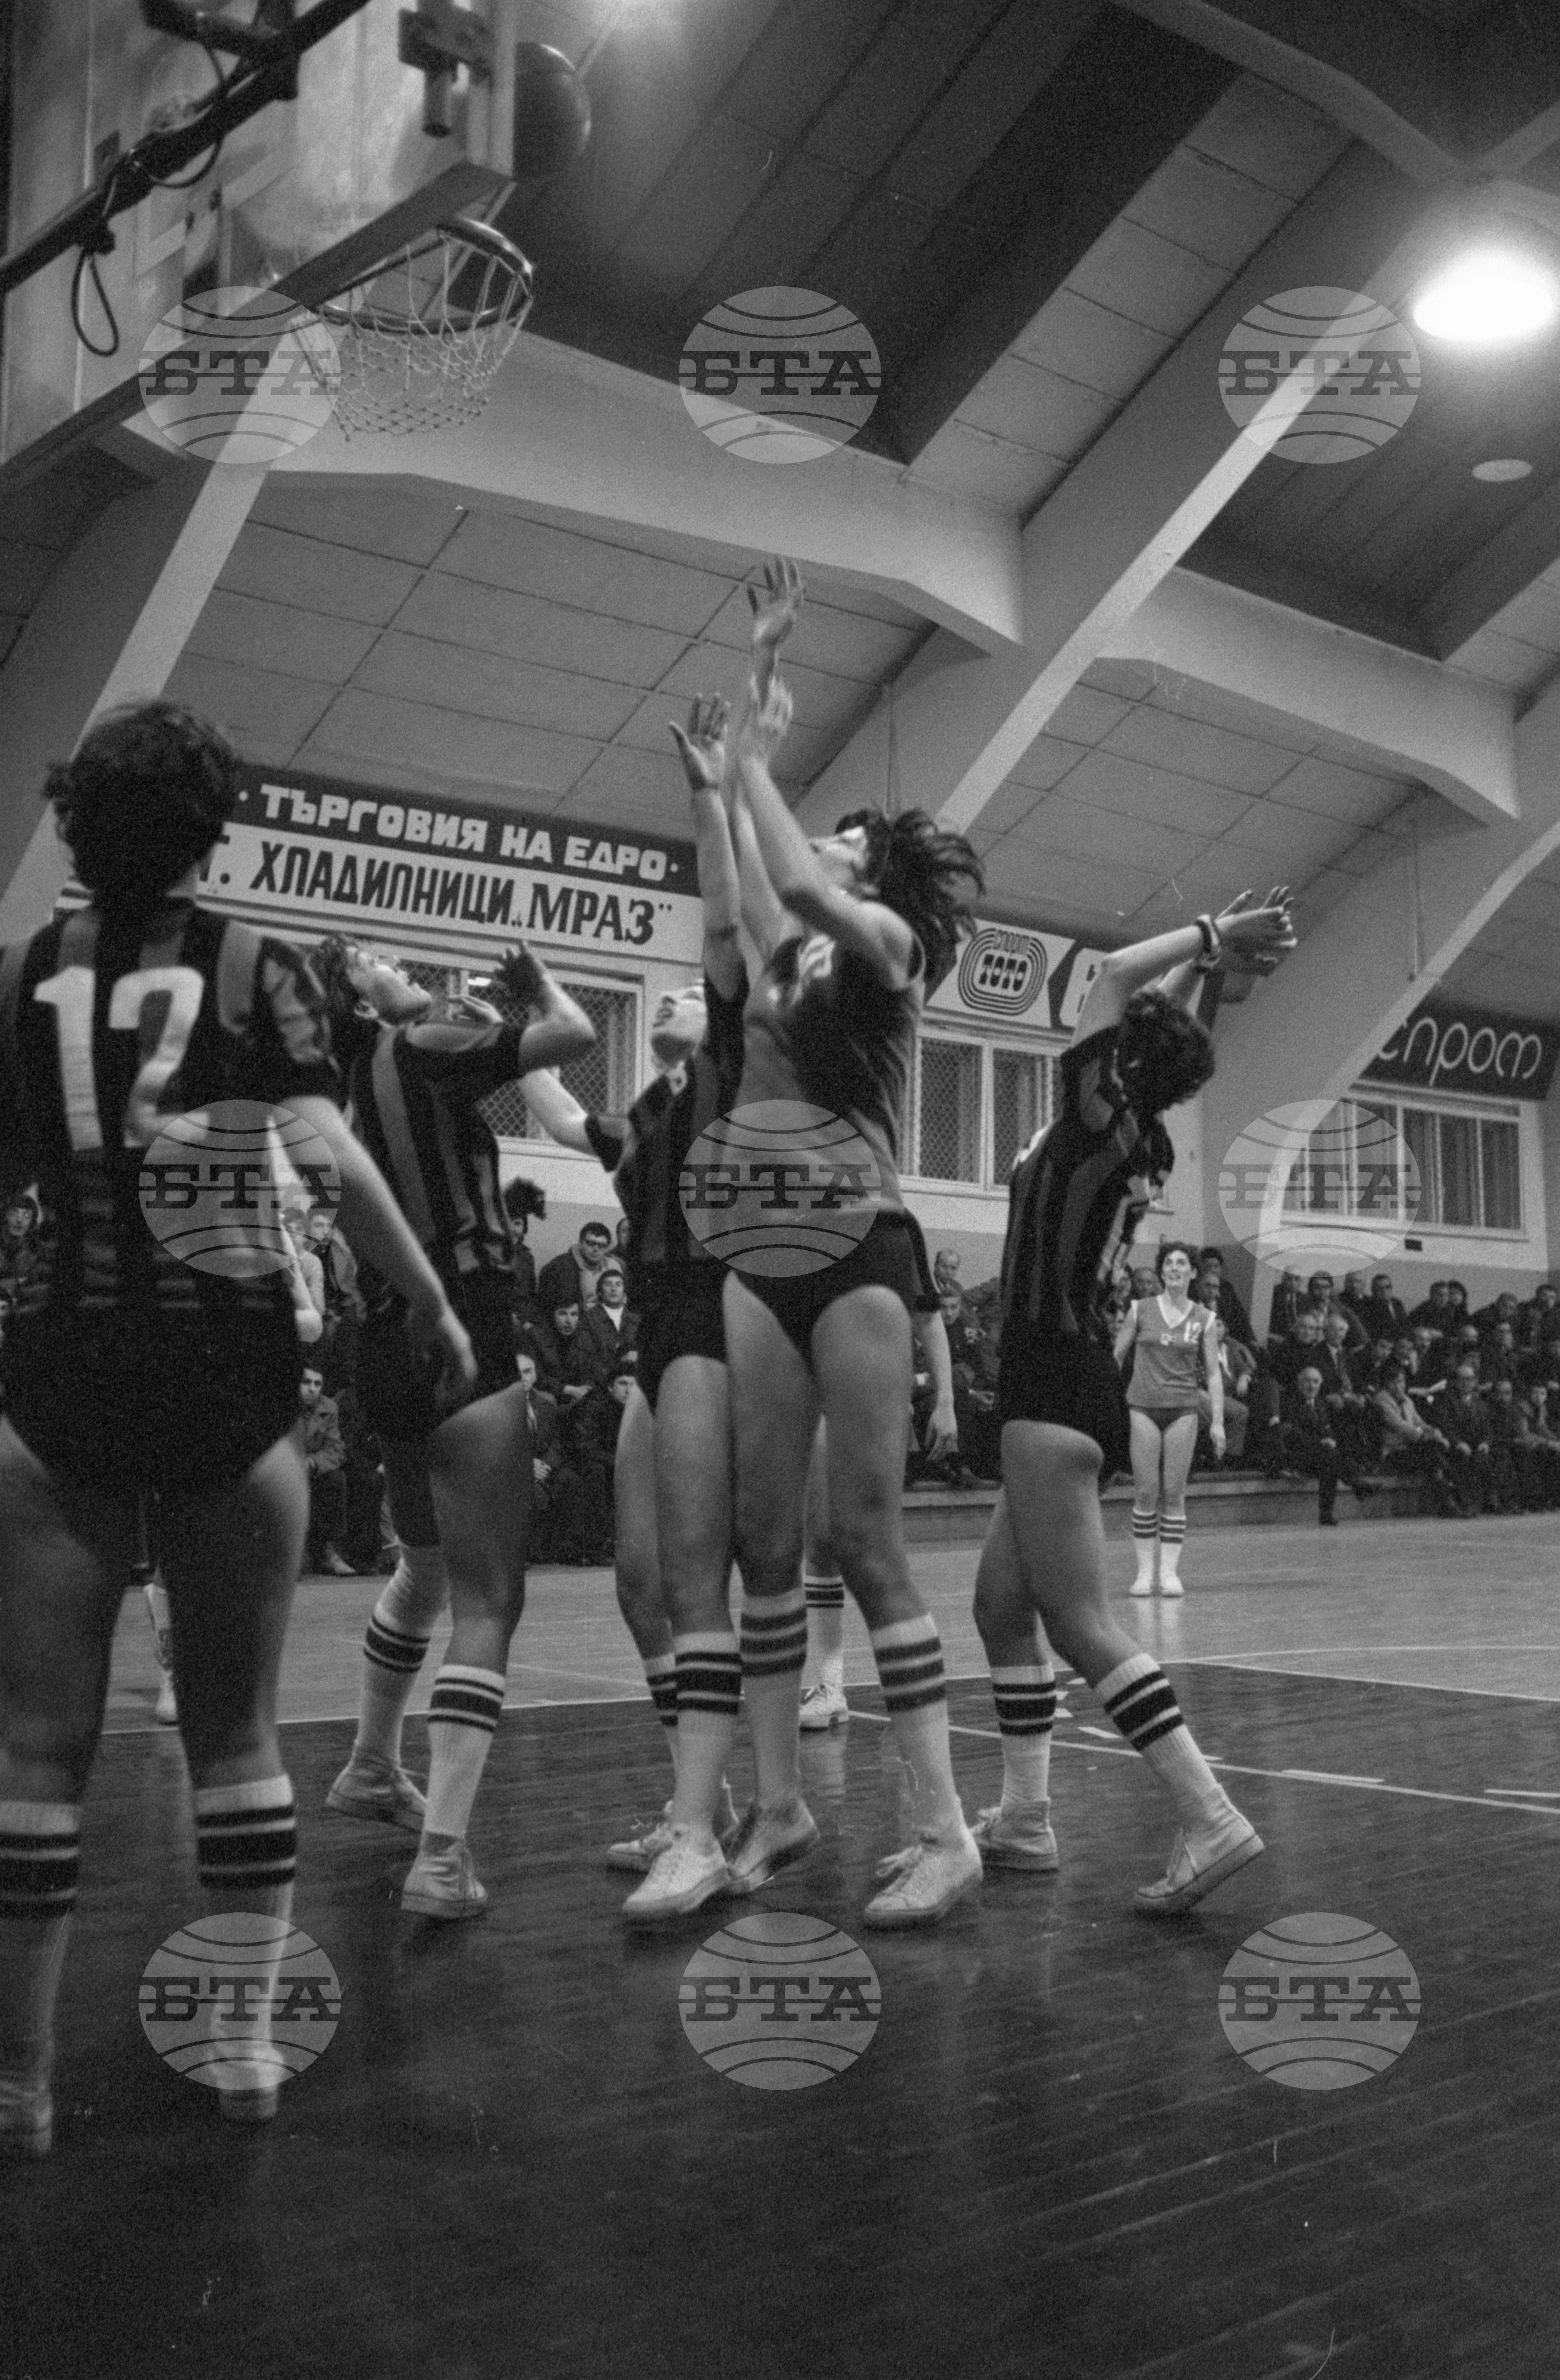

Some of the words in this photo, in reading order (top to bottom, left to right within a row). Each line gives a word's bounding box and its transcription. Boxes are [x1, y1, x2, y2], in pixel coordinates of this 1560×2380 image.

[261, 784, 488, 852] ТЪРГОВИЯ
[500, 825, 552, 863] НА
[564, 835, 667, 881] ЕДРО
[249, 840, 515, 925] ХЛАДИЛНИЦИ
[33, 966, 209, 1151] 12
[1183, 1321, 1201, 1344] 12
